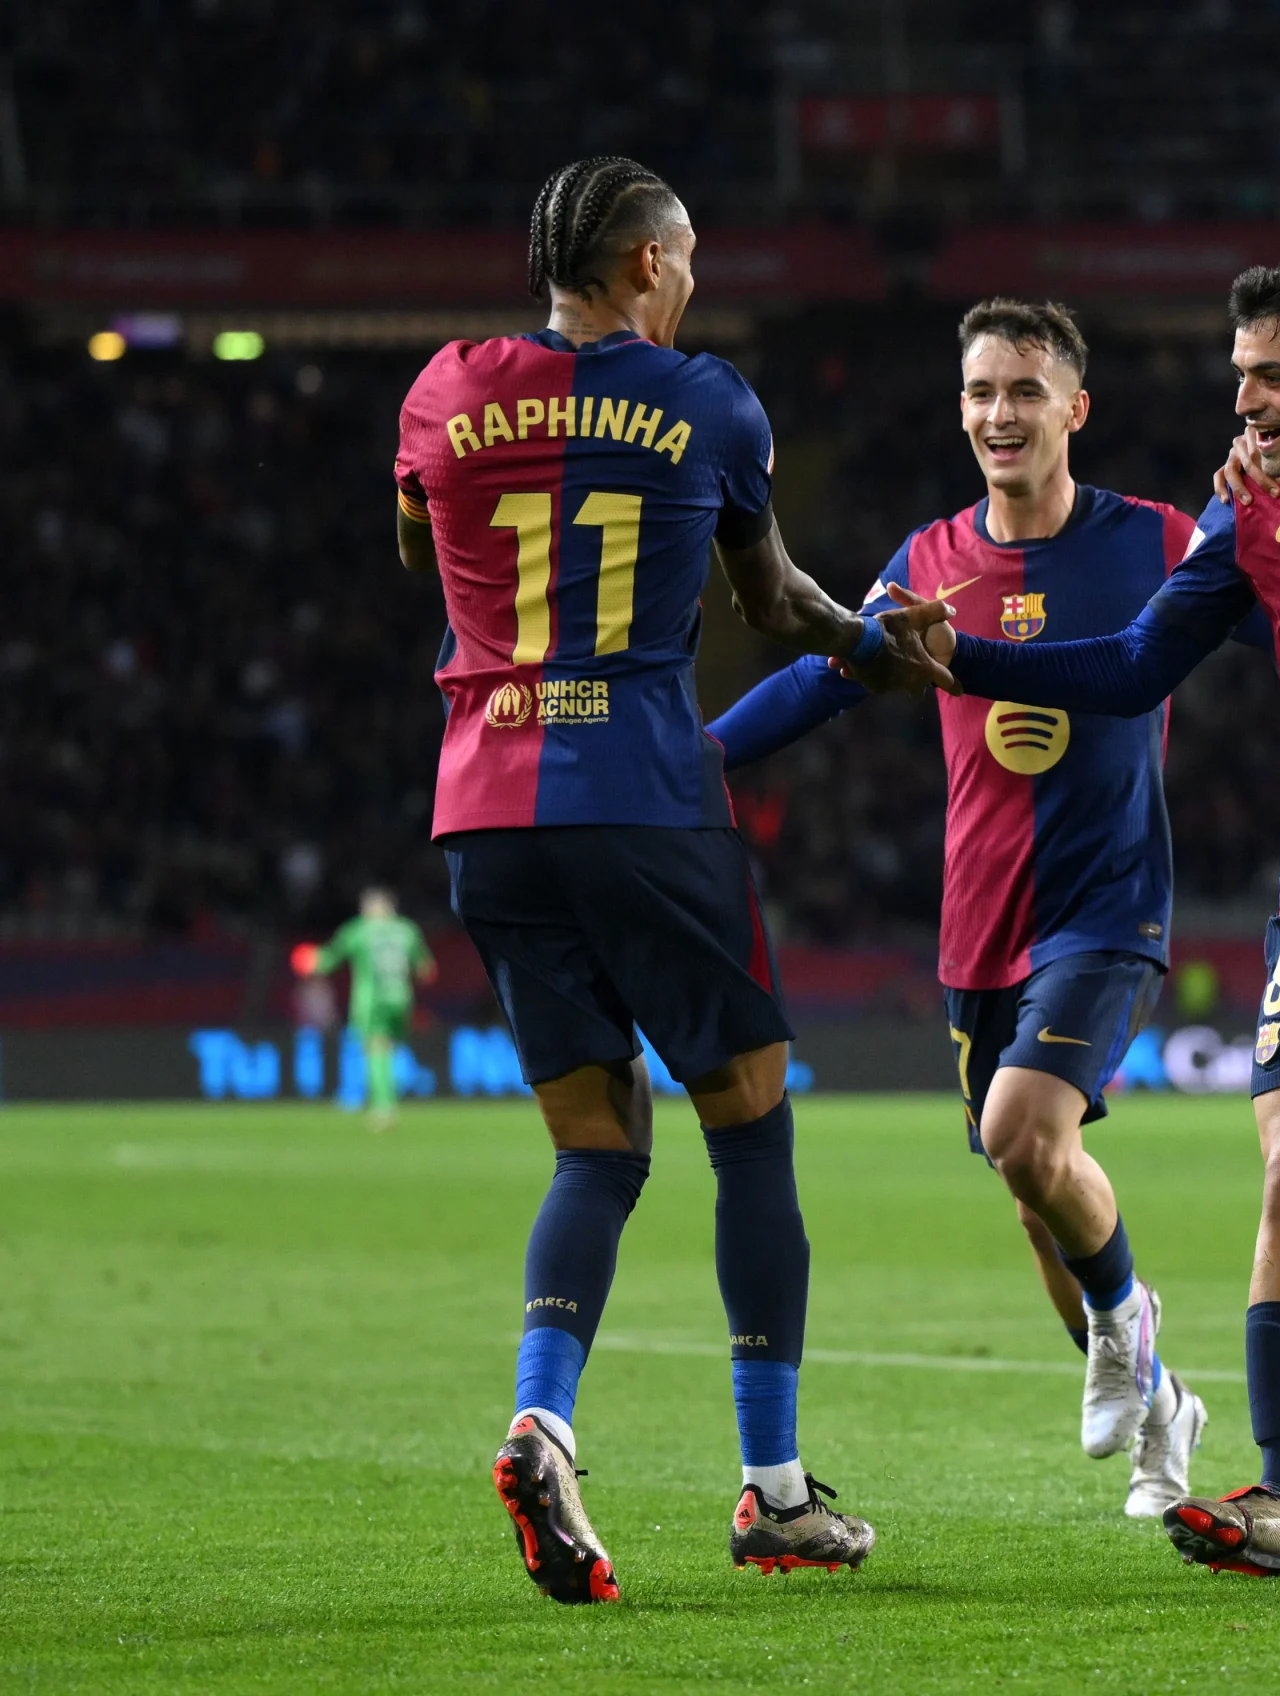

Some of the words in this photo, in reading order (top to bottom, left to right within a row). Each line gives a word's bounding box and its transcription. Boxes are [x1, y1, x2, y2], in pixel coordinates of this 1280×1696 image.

[446, 396, 692, 465] RAPHINHA
[489, 491, 642, 664] 11
[535, 680, 609, 699] UNHCR
[536, 699, 610, 718] ACNUR
[553, 717, 582, 725] Refugee
[583, 716, 609, 725] Agency
